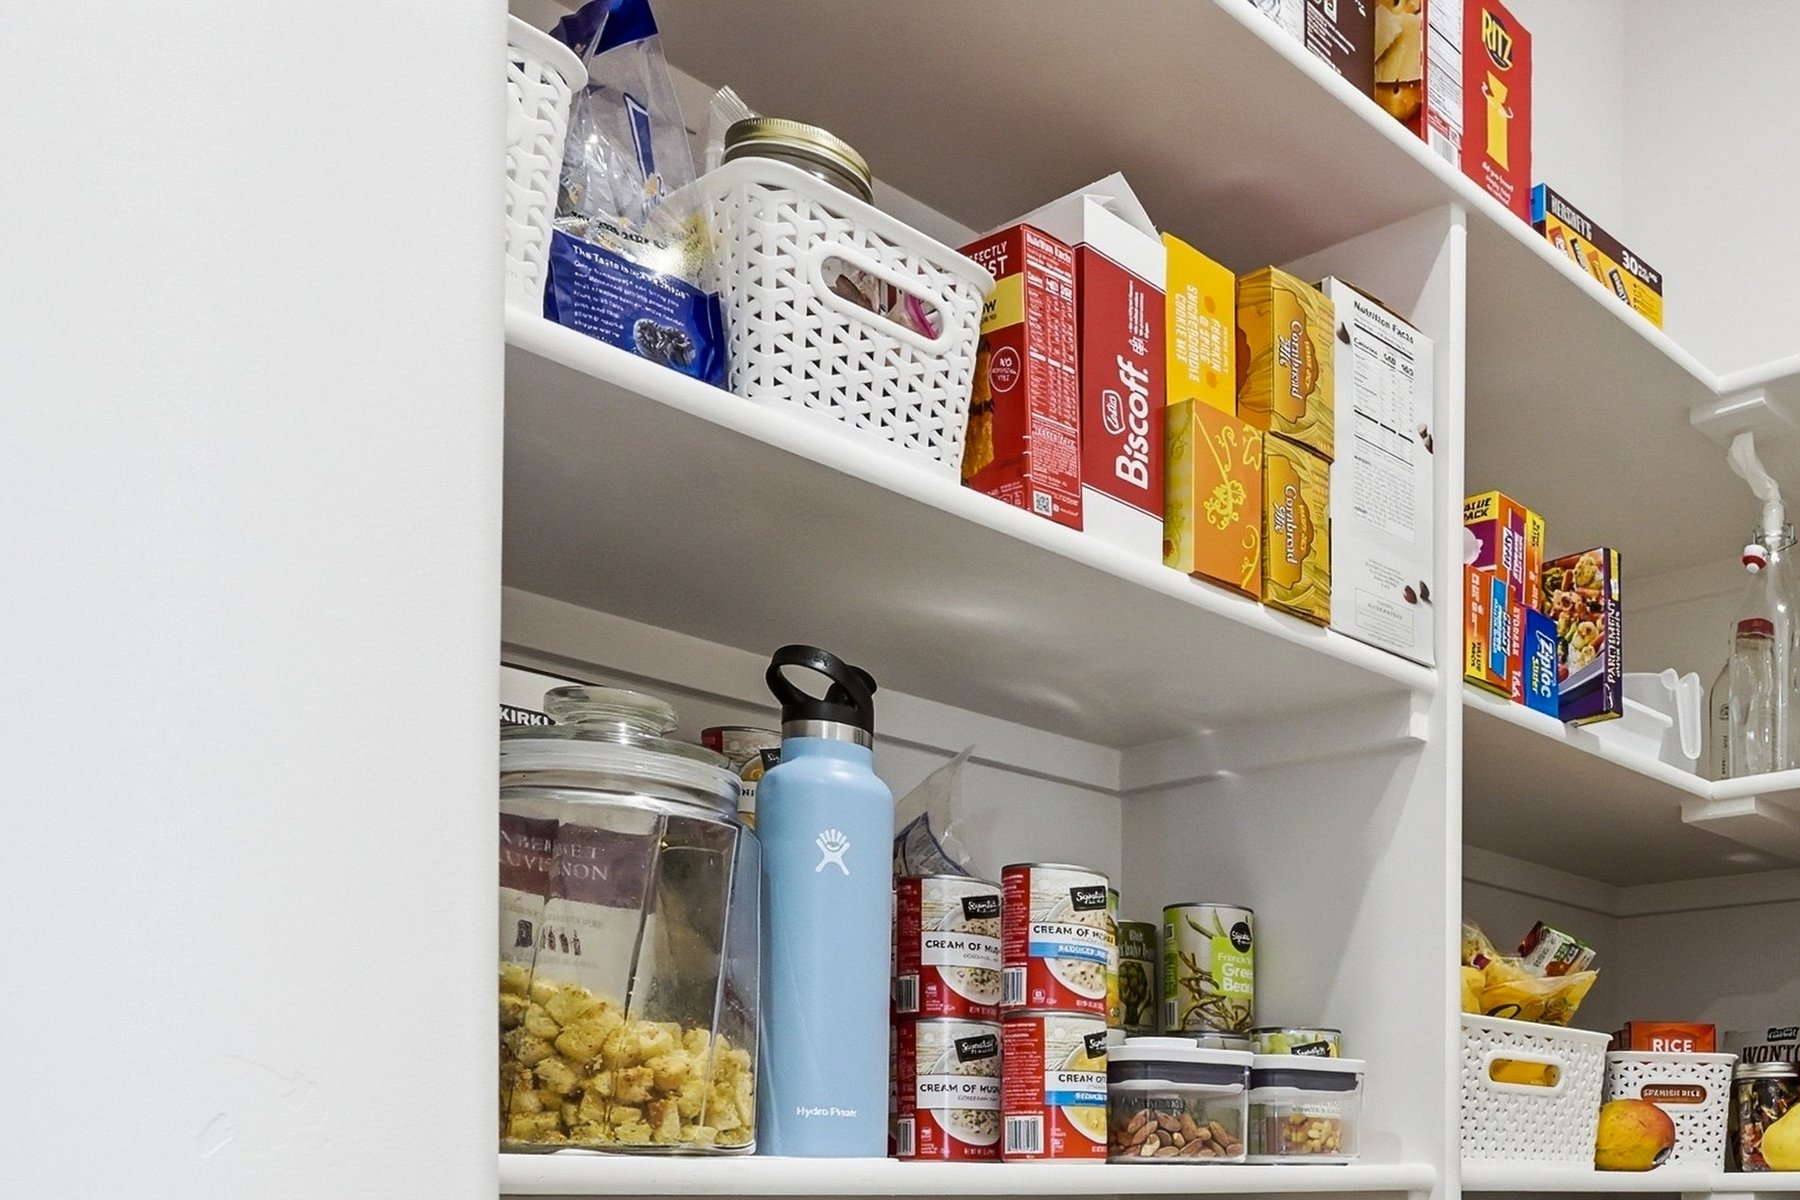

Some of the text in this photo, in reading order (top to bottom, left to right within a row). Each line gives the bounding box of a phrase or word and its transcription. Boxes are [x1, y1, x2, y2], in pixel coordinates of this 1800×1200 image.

[1482, 7, 1513, 68] RITZ
[968, 241, 1008, 263] FECTLY
[1621, 250, 1638, 276] 30
[1115, 354, 1149, 490] Biscoff
[1539, 639, 1553, 699] Ziploc
[1033, 925, 1090, 936] CREAM OF
[925, 940, 965, 950] CREAM
[968, 942, 981, 951] OF
[1652, 1038, 1693, 1052] RICE
[1058, 1074, 1094, 1084] CREAM
[920, 1083, 958, 1093] CREAM
[963, 1083, 976, 1093] OF
[1643, 1088, 1680, 1098] SPANISH
[797, 1106, 829, 1119] Hydro
